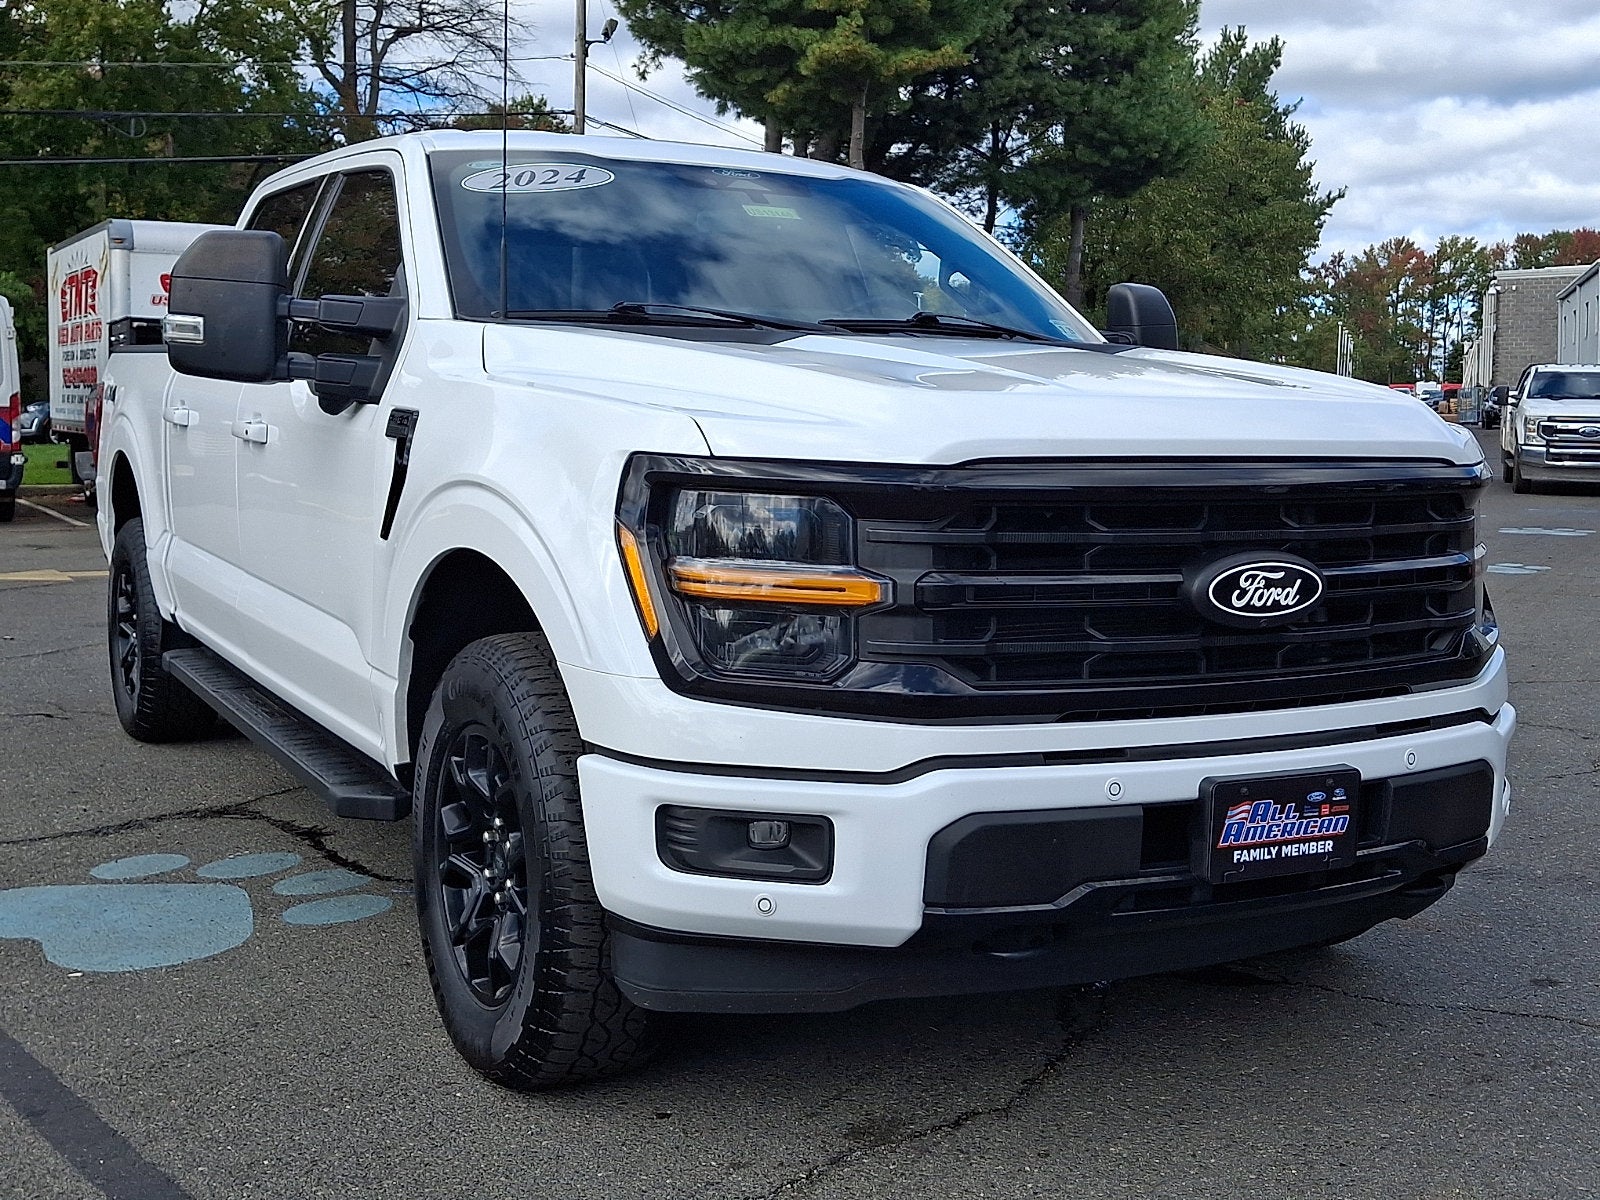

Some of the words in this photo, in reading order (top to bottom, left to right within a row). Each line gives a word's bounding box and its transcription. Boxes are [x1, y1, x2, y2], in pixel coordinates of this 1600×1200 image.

[488, 168, 587, 190] 2024
[1231, 570, 1302, 607] Ford
[1248, 800, 1300, 825] ALL
[1219, 815, 1350, 846] AMERICAN
[1233, 846, 1279, 863] FAMILY
[1281, 840, 1334, 857] MEMBER
